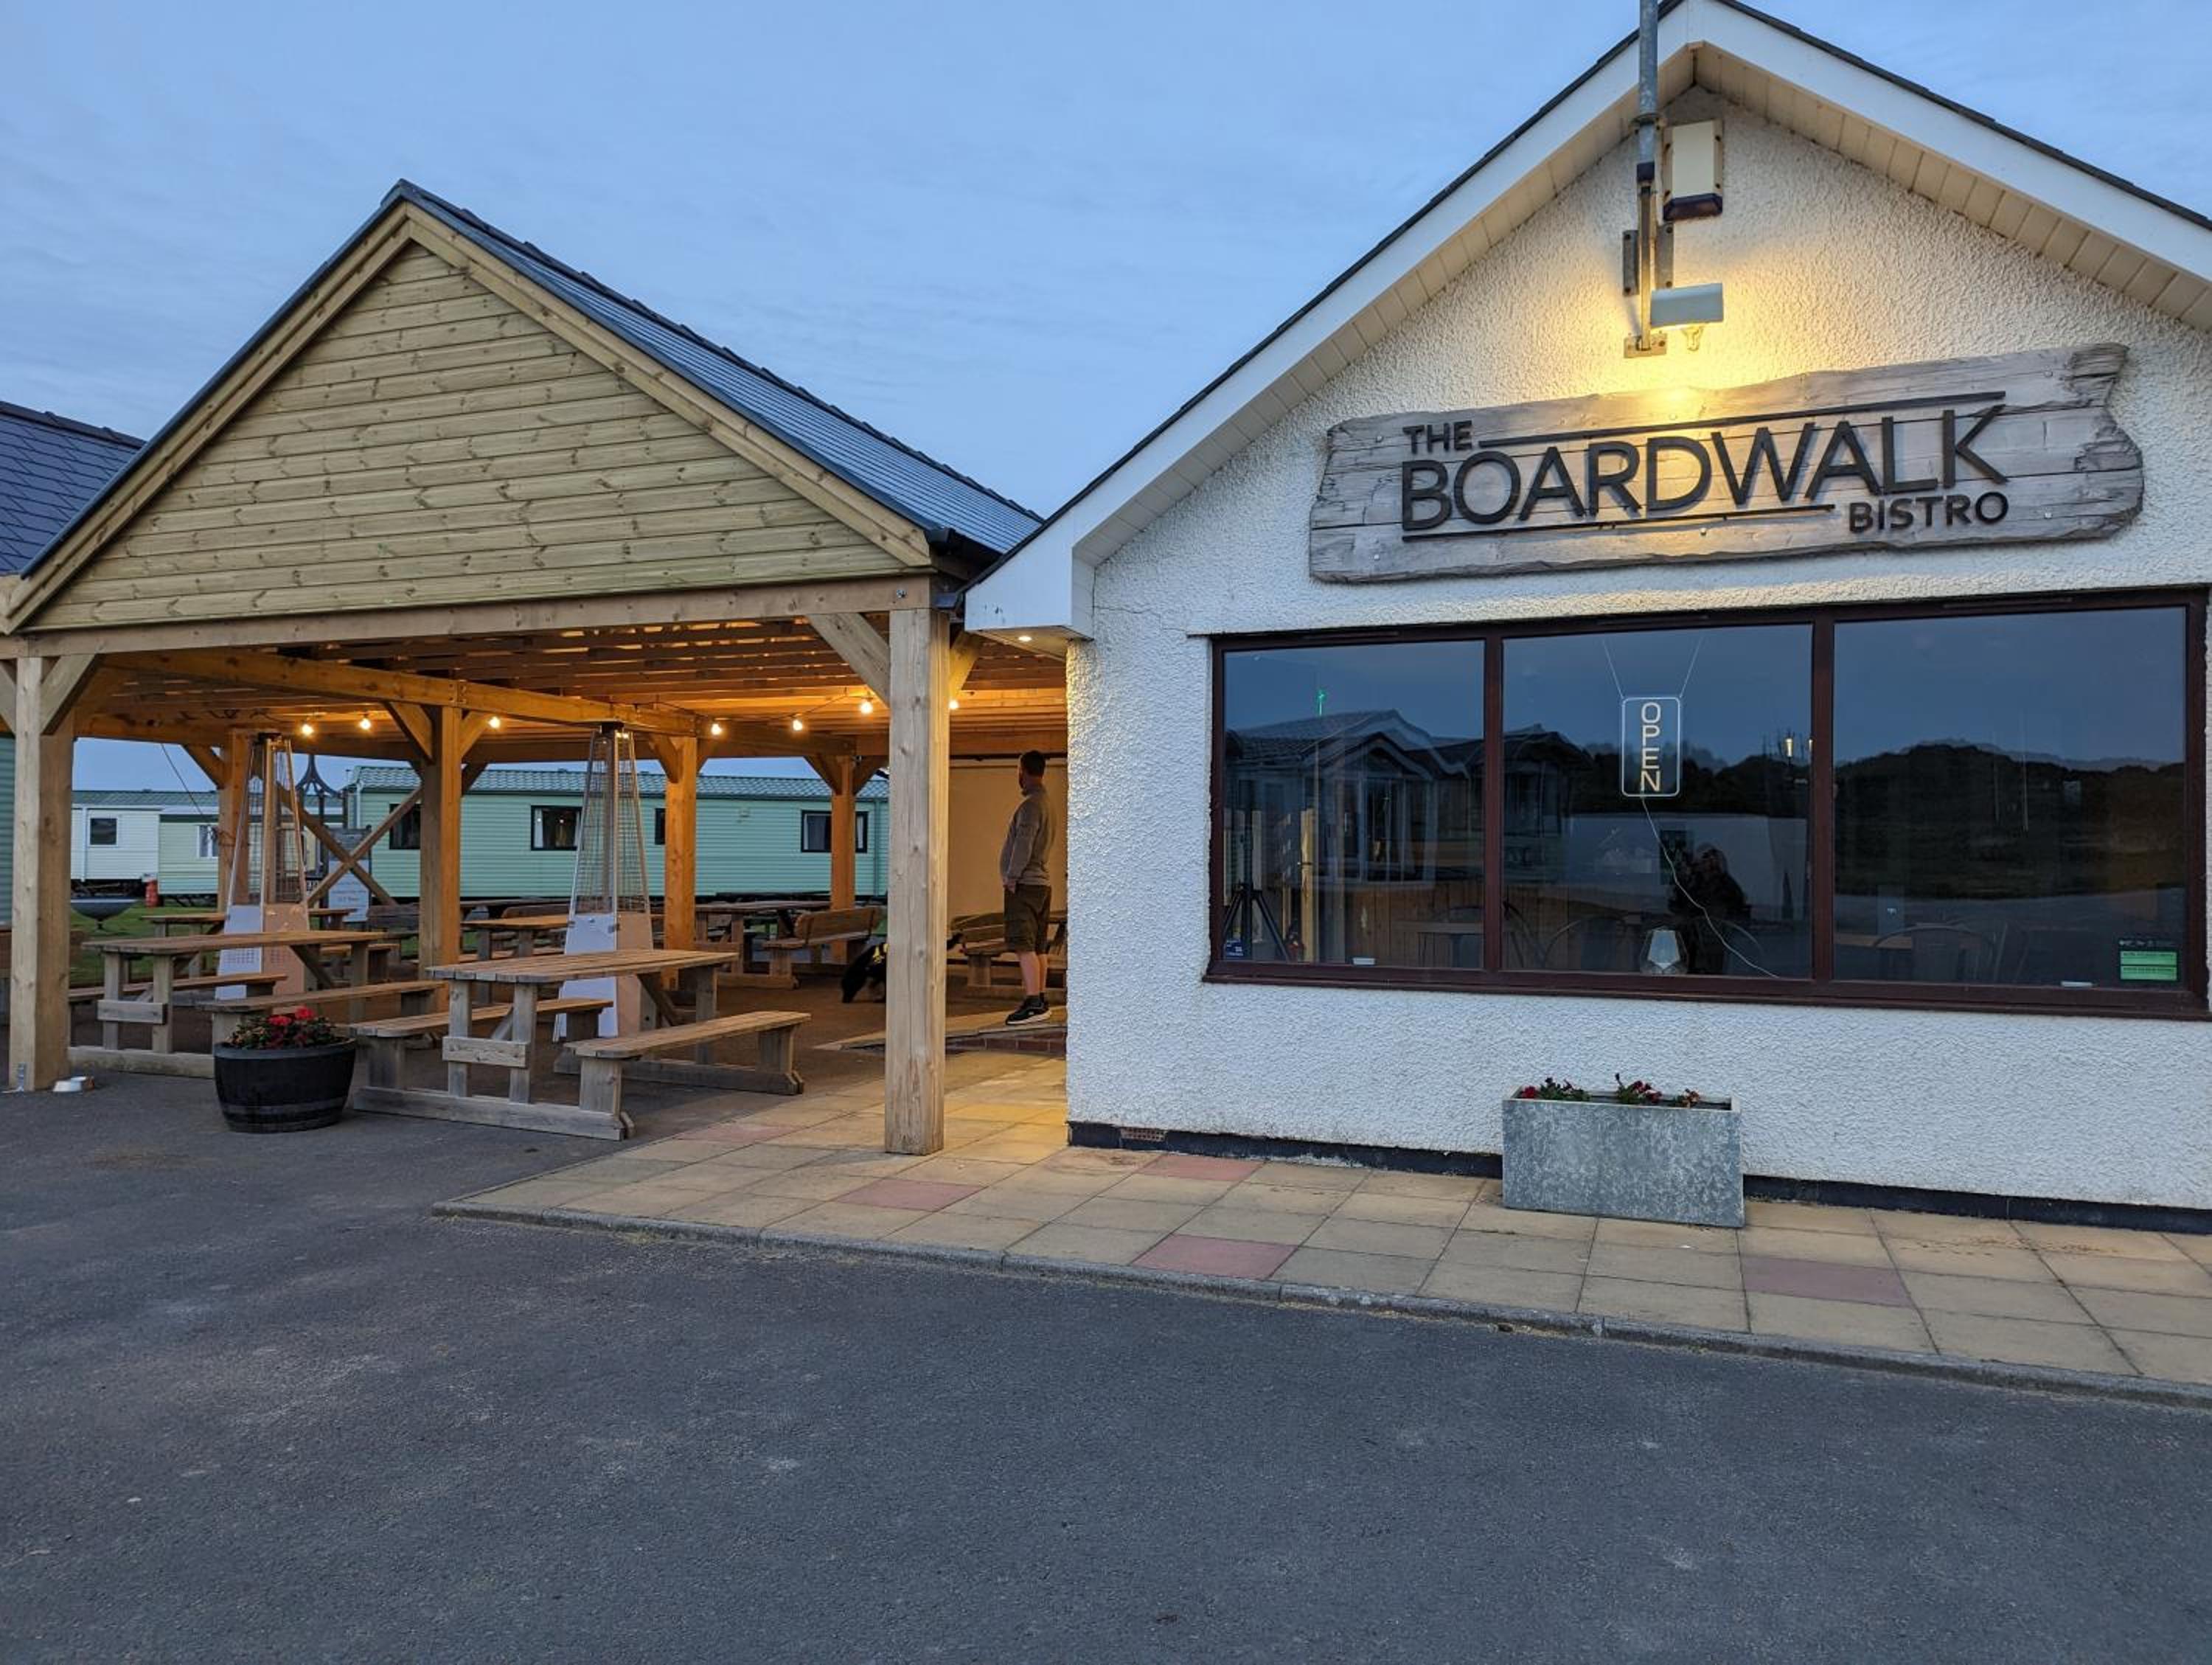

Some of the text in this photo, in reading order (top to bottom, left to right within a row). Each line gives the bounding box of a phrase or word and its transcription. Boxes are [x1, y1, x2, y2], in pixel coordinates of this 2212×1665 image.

[1402, 420, 1473, 455] THE
[1402, 403, 2010, 531] BOARDWALK
[1849, 491, 2009, 531] BISTRO
[1641, 701, 1661, 792] OPEN
